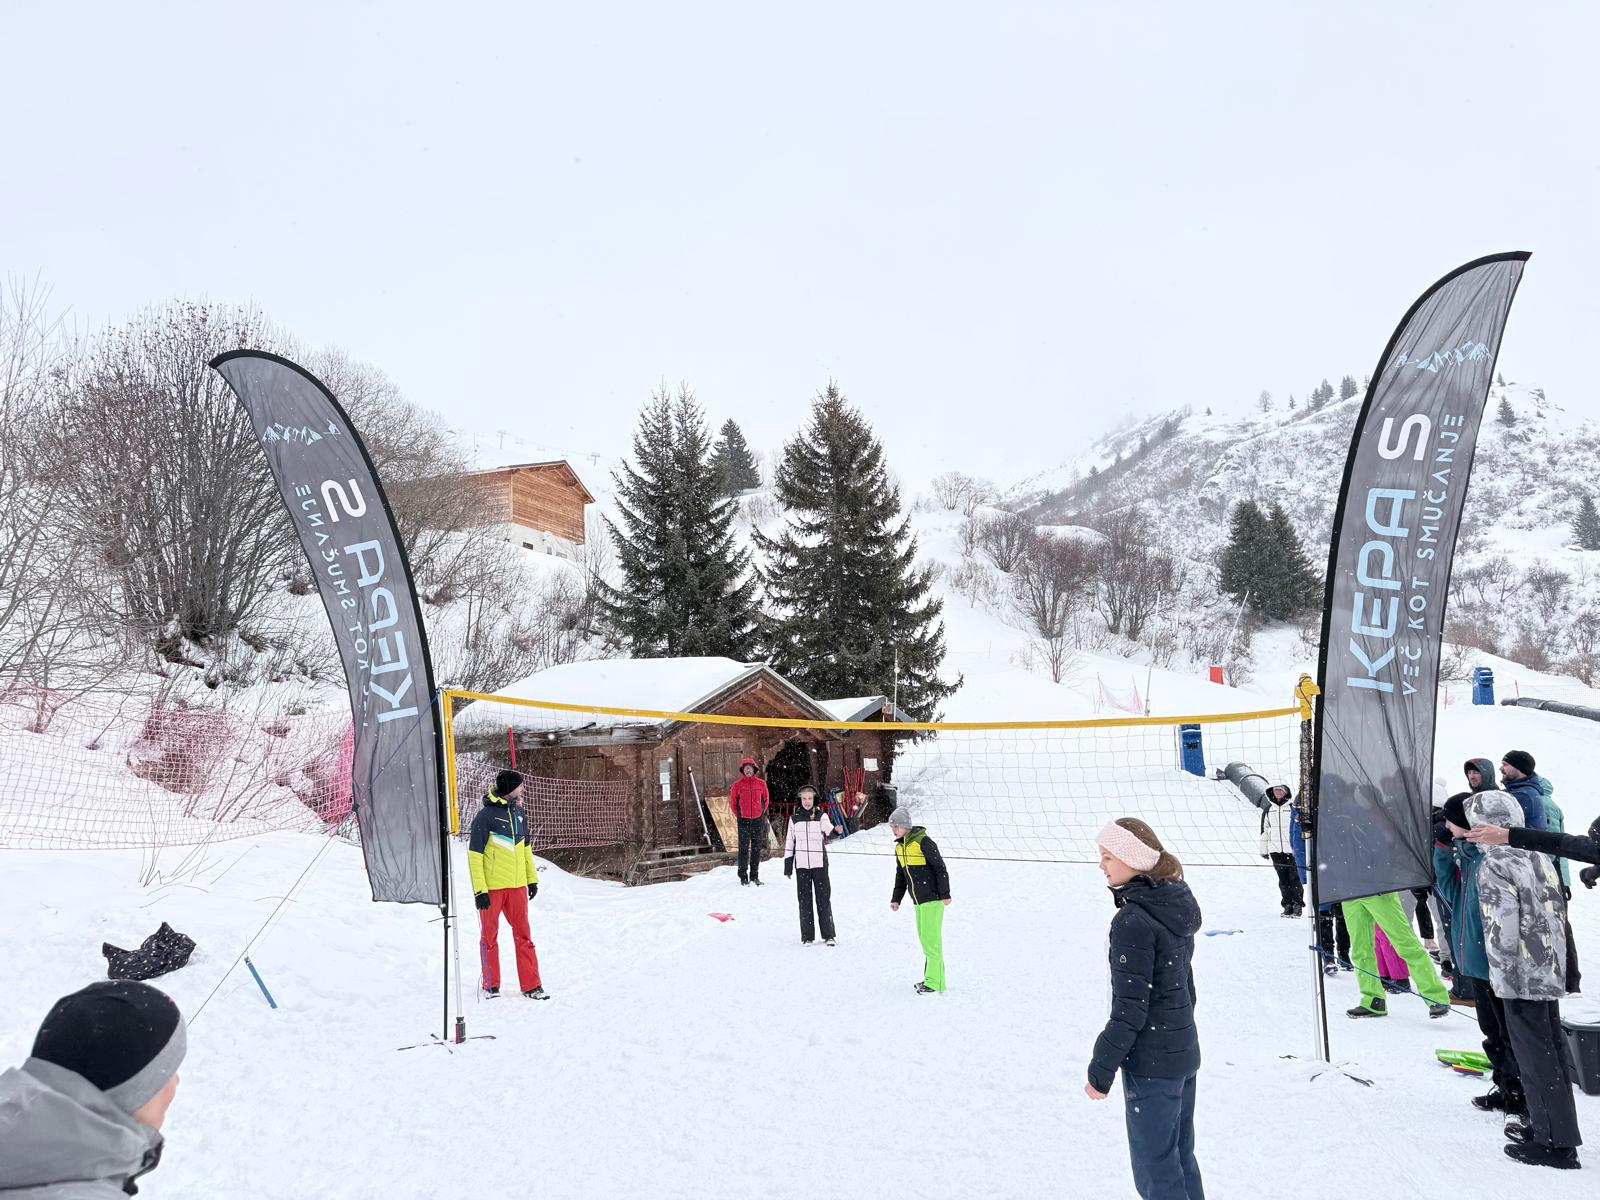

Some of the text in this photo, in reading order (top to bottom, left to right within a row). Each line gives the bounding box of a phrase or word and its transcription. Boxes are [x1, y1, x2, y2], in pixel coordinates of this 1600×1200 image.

[1347, 413, 1432, 693] KEPA S
[1400, 414, 1465, 696] VEČ KOT SMUČANJE
